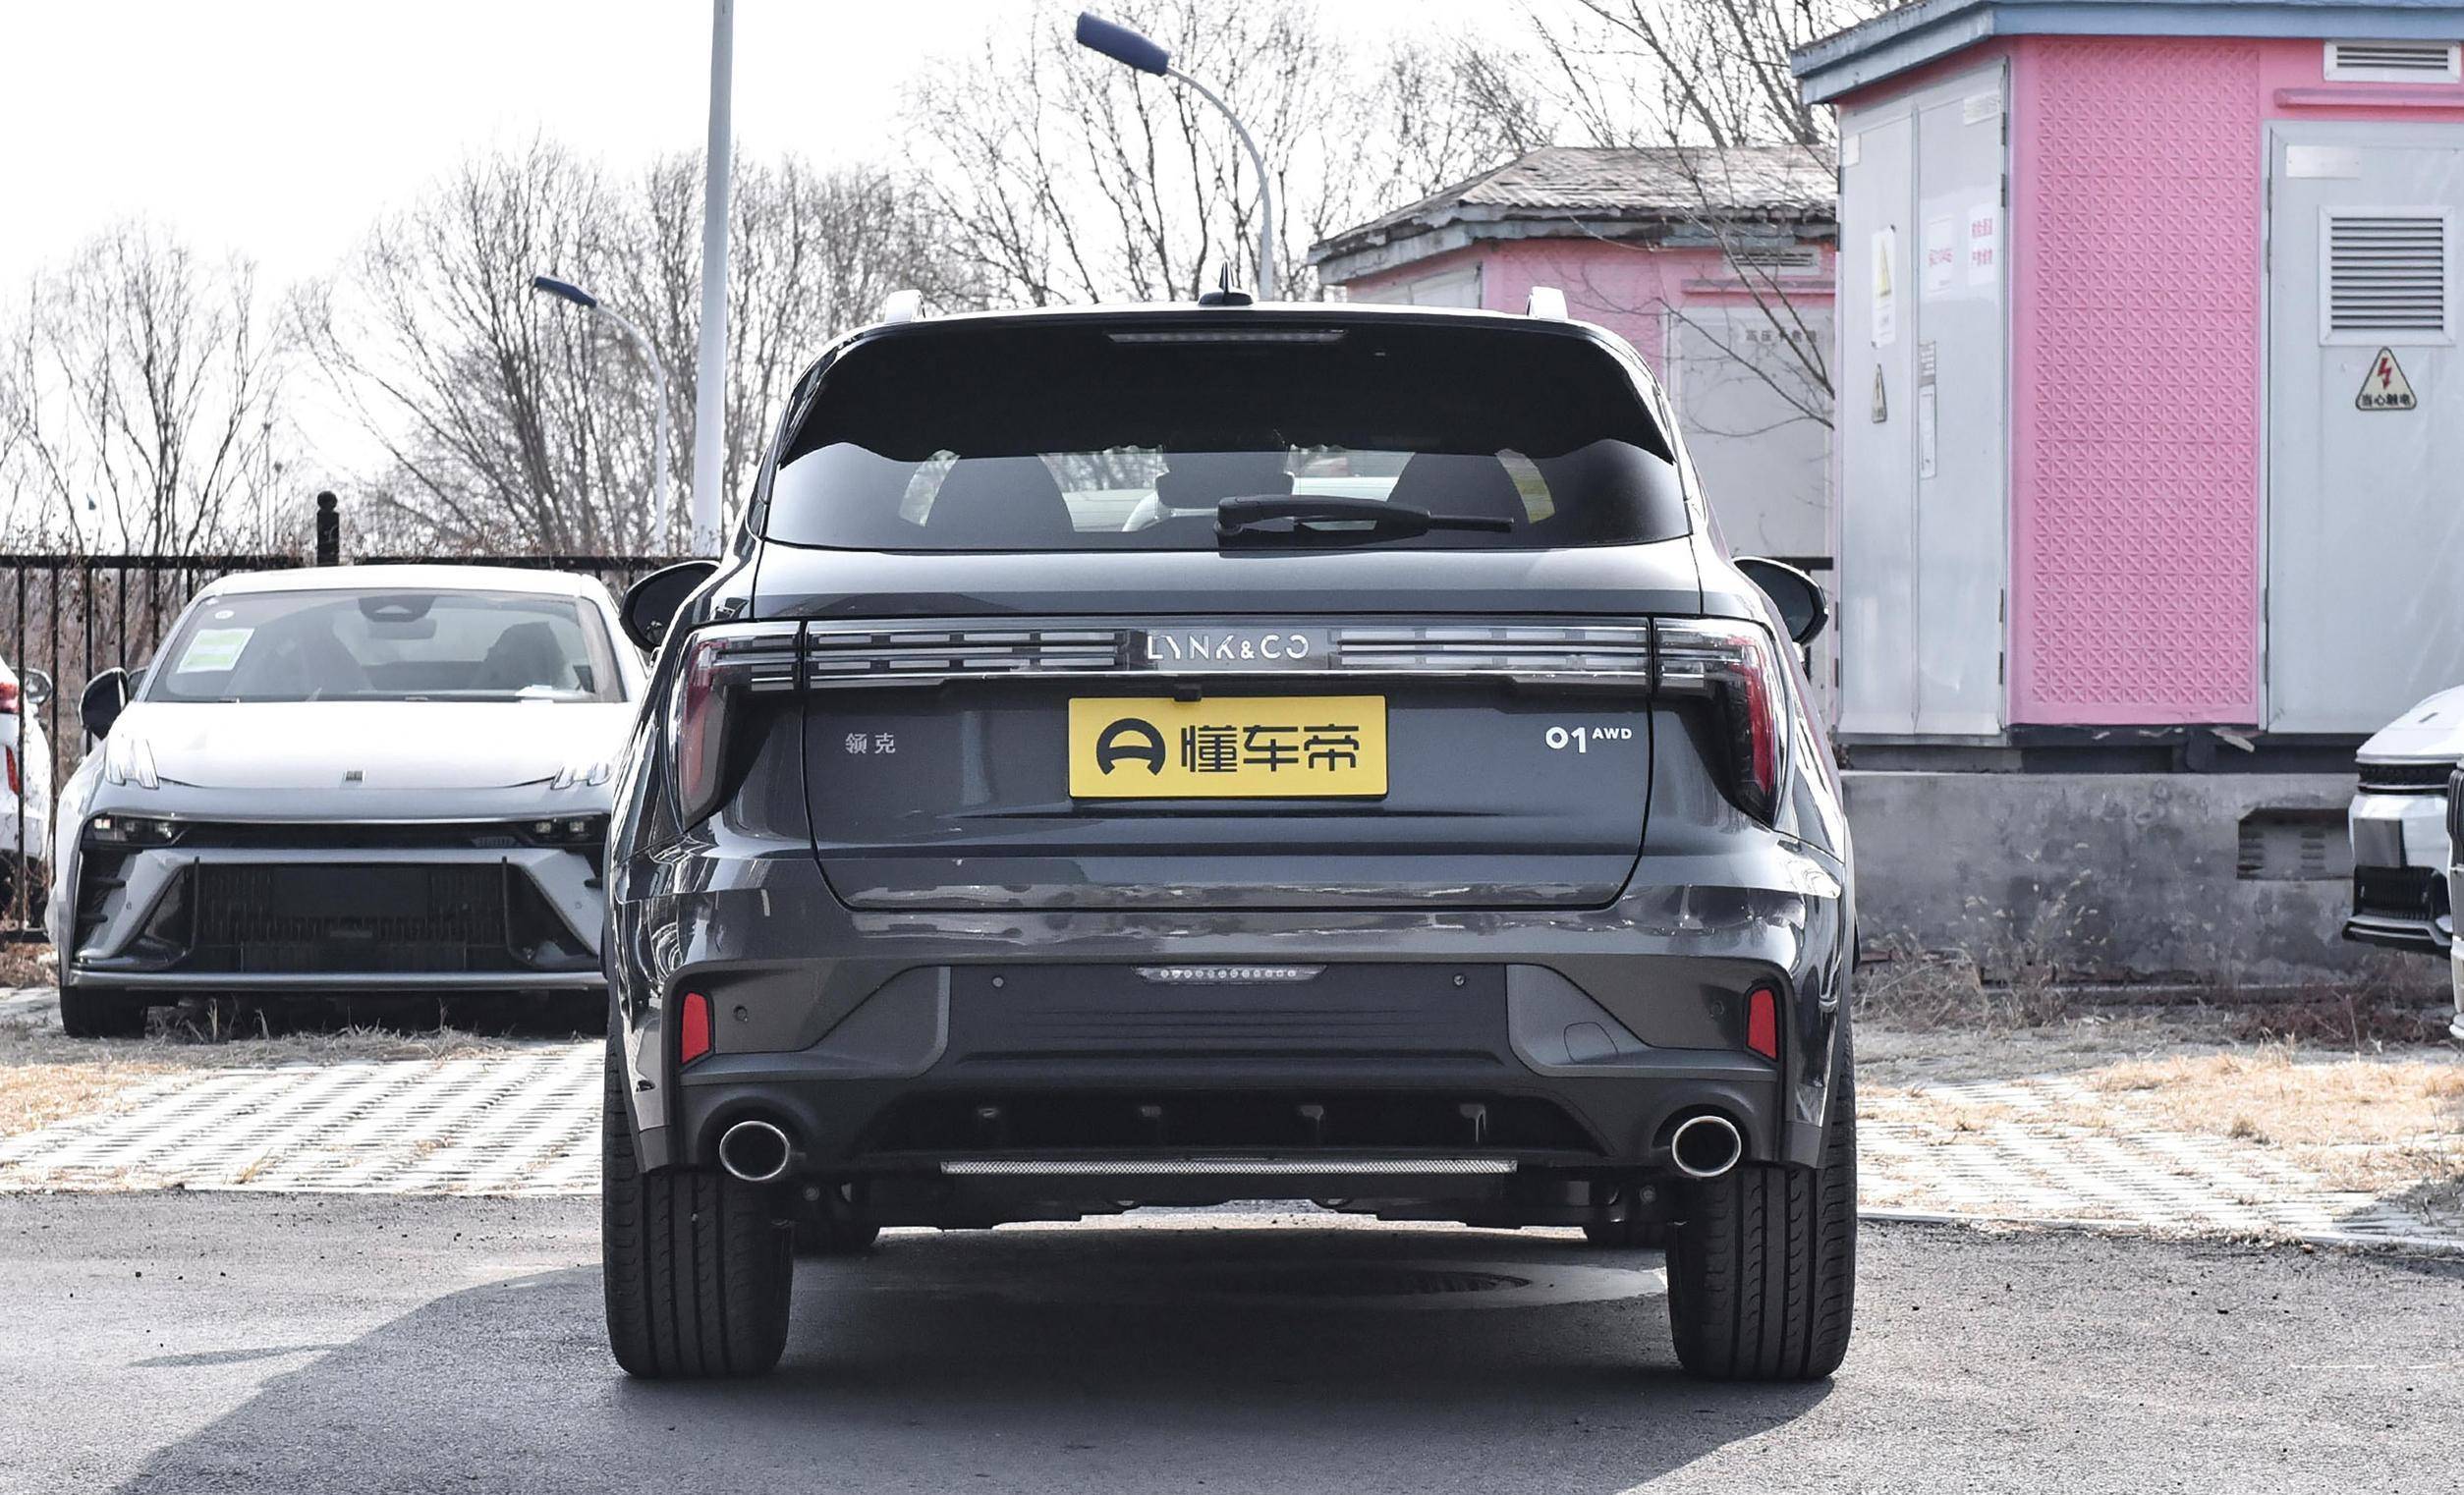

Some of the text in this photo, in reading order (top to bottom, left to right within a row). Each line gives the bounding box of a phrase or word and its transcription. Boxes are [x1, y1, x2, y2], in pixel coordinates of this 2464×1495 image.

[1148, 635, 1310, 659] LYNK&CO
[845, 732, 896, 754] 领克
[1592, 727, 1633, 740] AWD
[1181, 723, 1360, 773] 懂车帝
